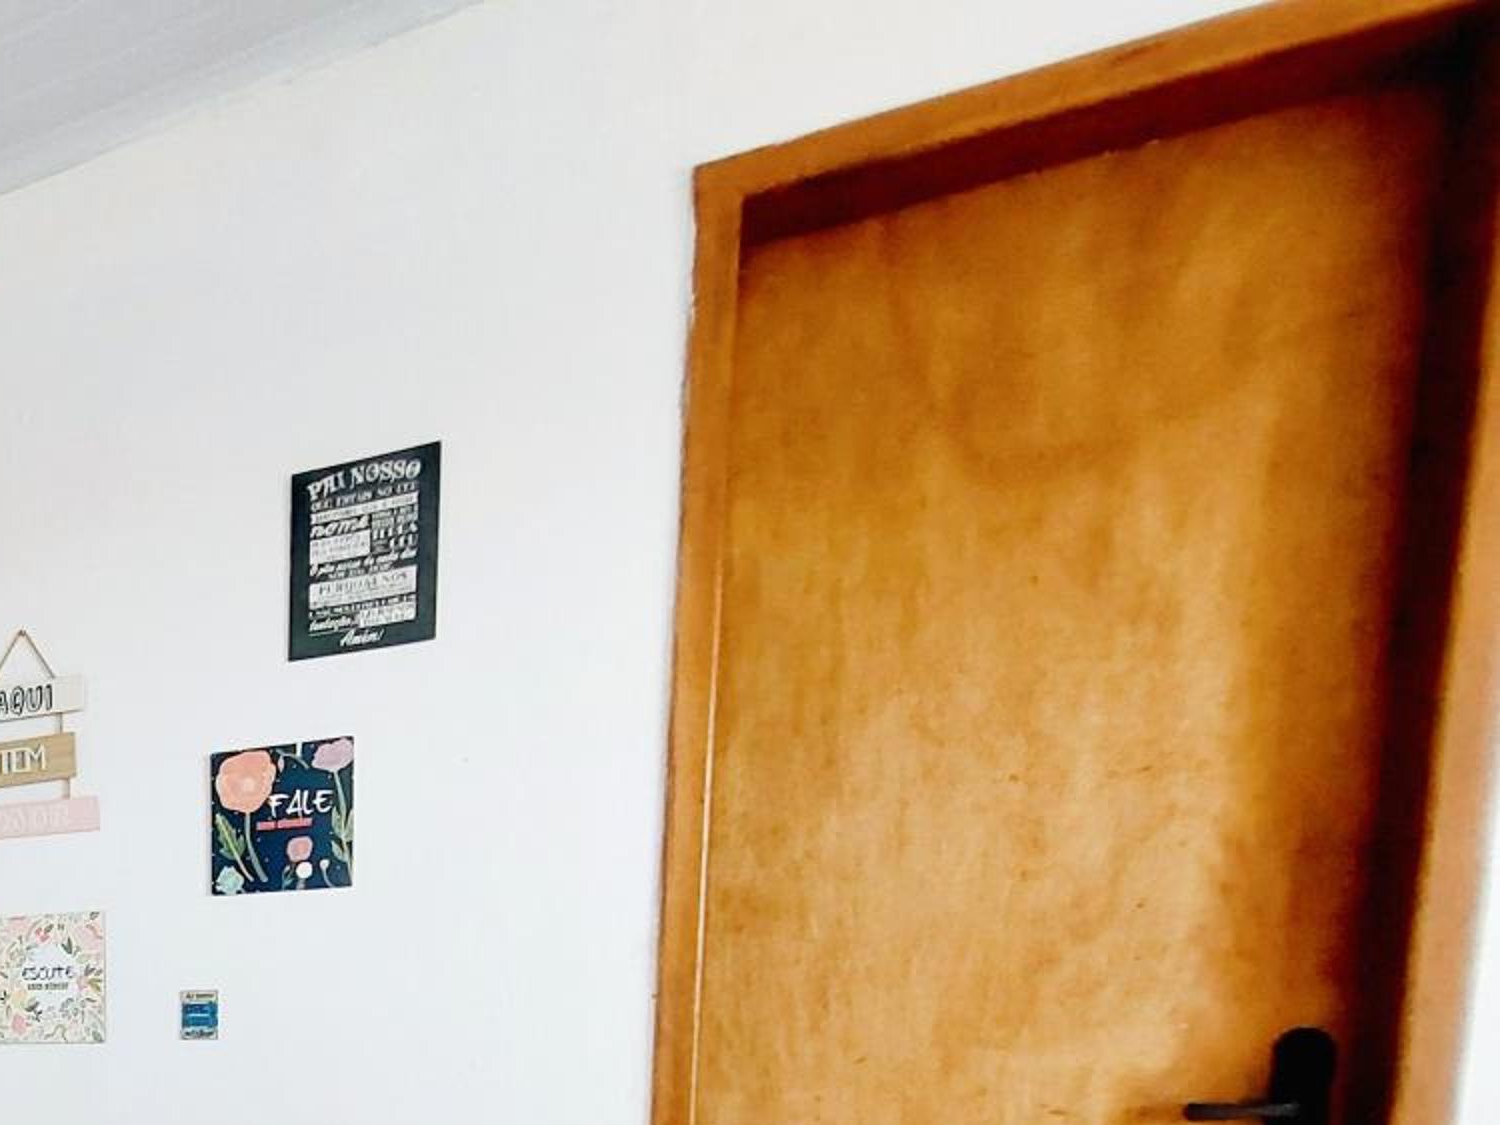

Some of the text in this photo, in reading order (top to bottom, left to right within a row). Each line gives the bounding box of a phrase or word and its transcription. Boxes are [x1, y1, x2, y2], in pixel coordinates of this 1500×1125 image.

[306, 471, 346, 501] PAI
[351, 458, 421, 489] NOSSO
[268, 788, 333, 818] FALE
